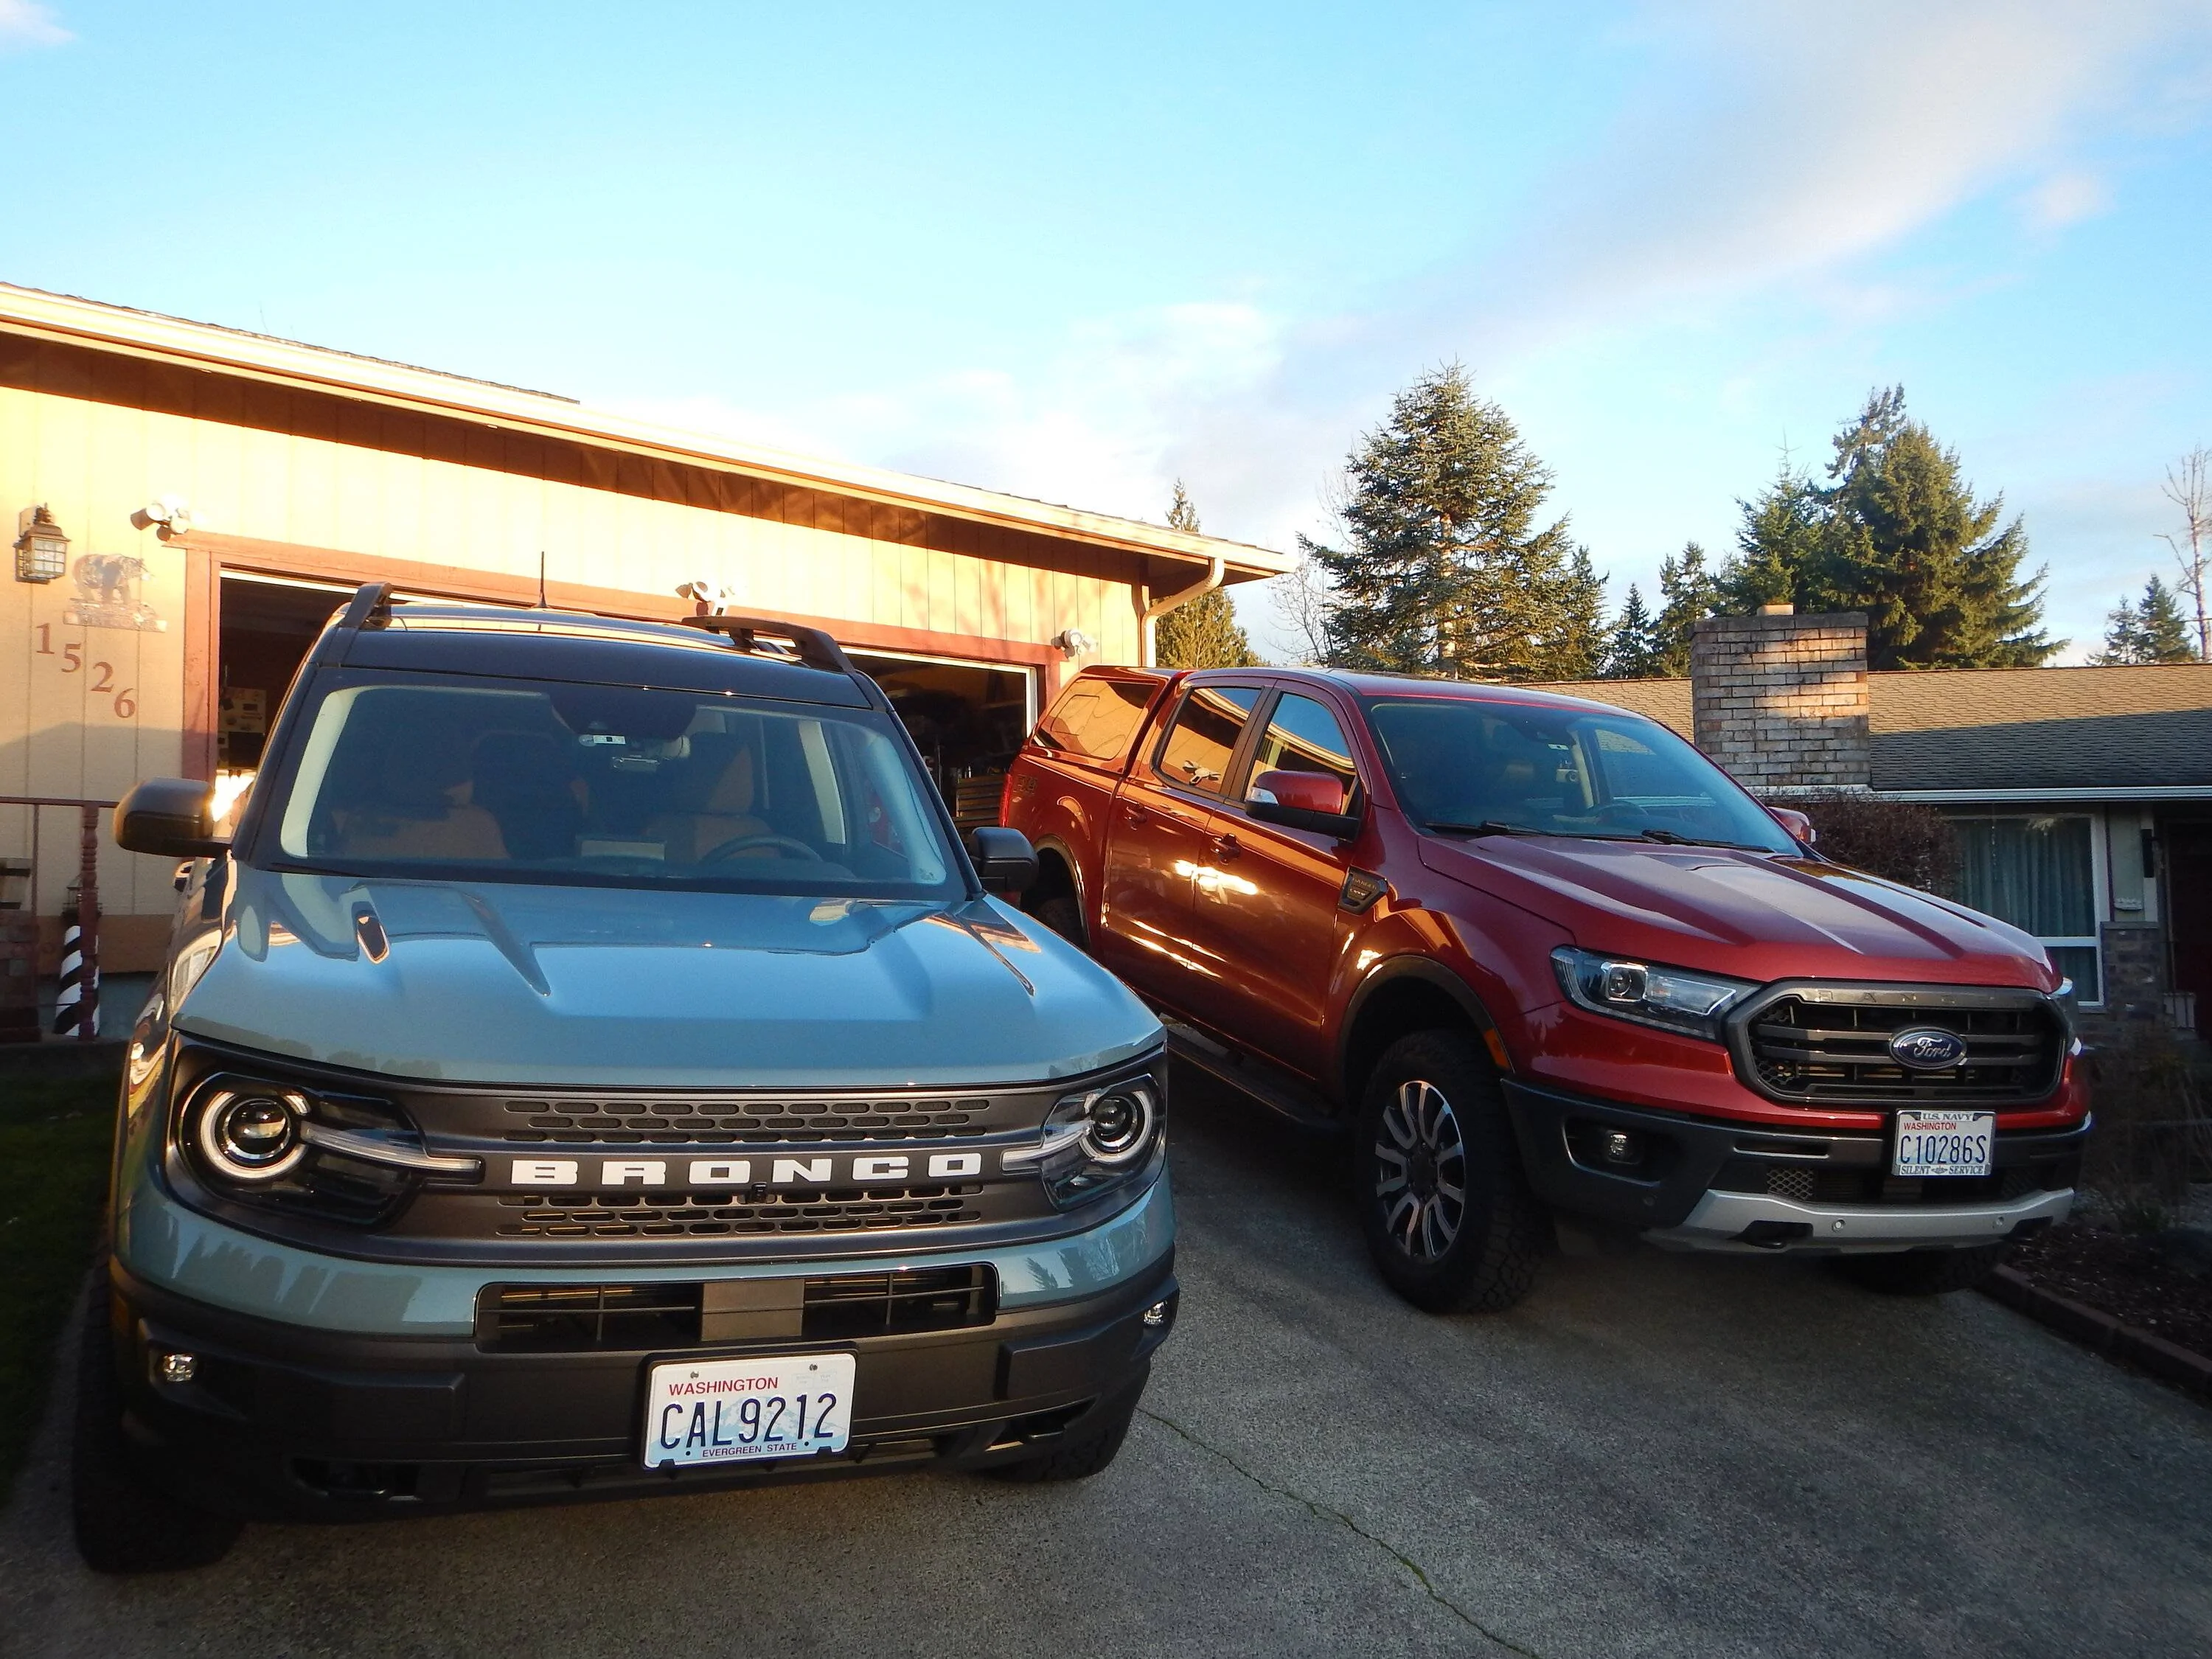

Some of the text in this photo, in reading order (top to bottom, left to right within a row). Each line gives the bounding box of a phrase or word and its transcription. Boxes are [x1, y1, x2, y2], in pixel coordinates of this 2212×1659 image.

[35, 623, 136, 719] 1526
[1913, 1037, 1952, 1057] Ford
[1904, 1122, 1957, 1130] WASHINGTON
[1900, 1134, 1987, 1164] C10286S
[511, 1152, 982, 1185] BRONCO
[1901, 1166, 1984, 1175] SILENT SERVICE
[669, 1377, 779, 1396] WASHINGTON
[661, 1393, 837, 1450] CAL9212
[702, 1442, 797, 1458] EVERGREEN STATE
